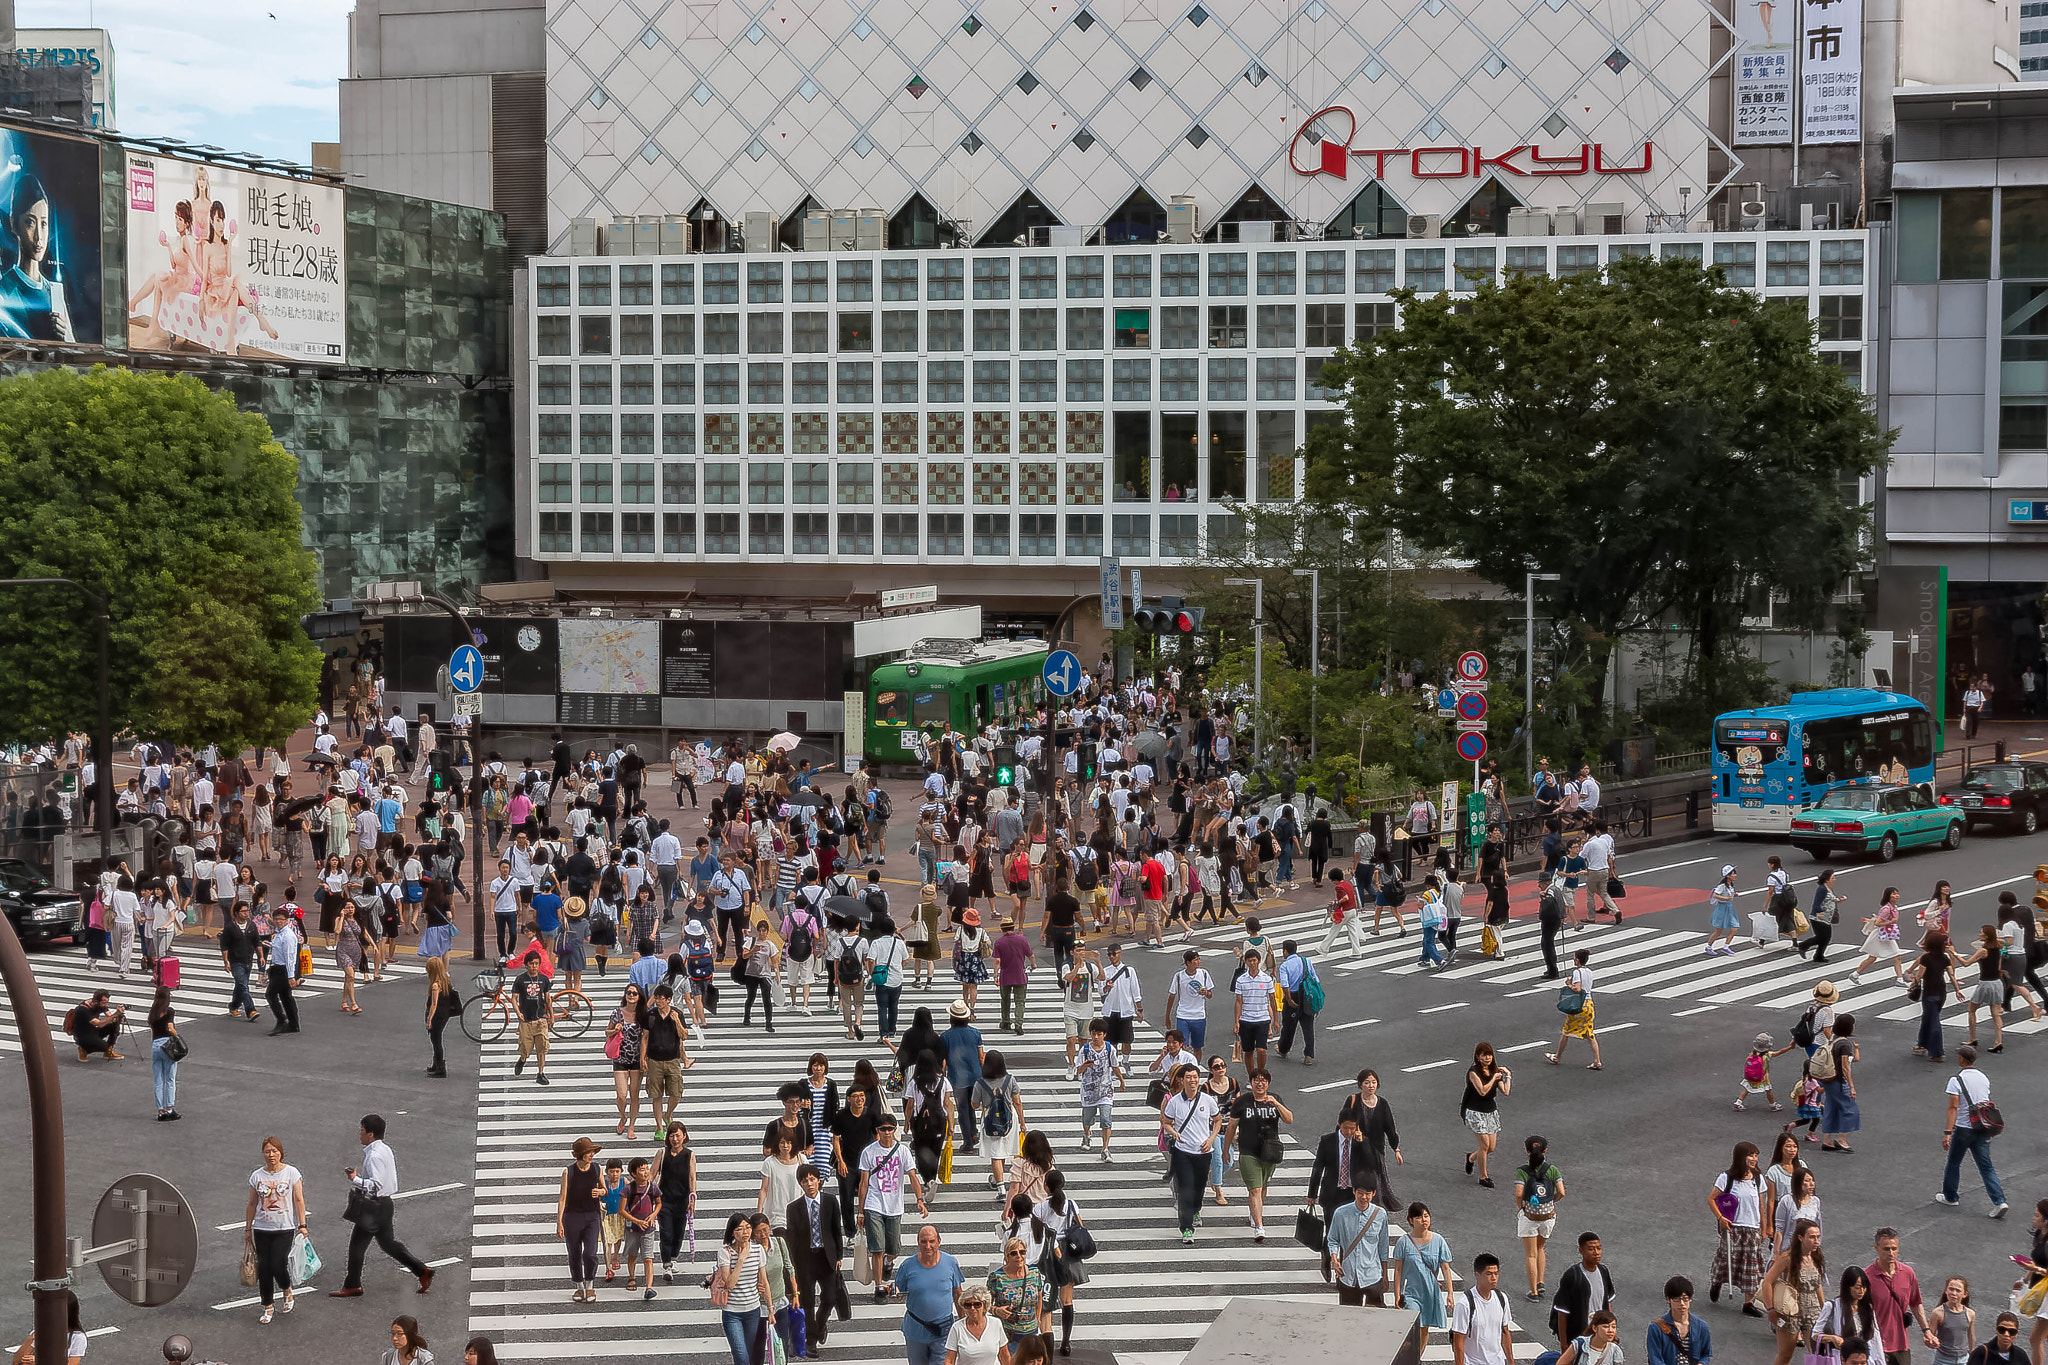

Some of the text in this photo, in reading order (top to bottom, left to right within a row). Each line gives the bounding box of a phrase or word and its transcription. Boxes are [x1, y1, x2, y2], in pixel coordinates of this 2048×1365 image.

[1743, 56, 1785, 67] 新規会員
[1743, 67, 1785, 78] 募集中
[1805, 72, 1858, 85] 8月13日(木)から
[1818, 86, 1857, 97] 18日(火)まで
[1741, 92, 1785, 103] 西館8階
[1738, 106, 1787, 115] カスタマー
[1738, 116, 1787, 125] センターへ
[1351, 141, 1652, 179] TOKYU
[131, 182, 153, 202] Labo
[248, 187, 320, 235] 脱毛娘。
[248, 237, 338, 284] 現在28歳
[1108, 563, 1120, 624] 渋谷駅前
[1918, 581, 1937, 712] Smoking Are
[457, 704, 480, 716] 8-22
[1770, 732, 1778, 740] Q
[1804, 756, 1810, 765] Q
